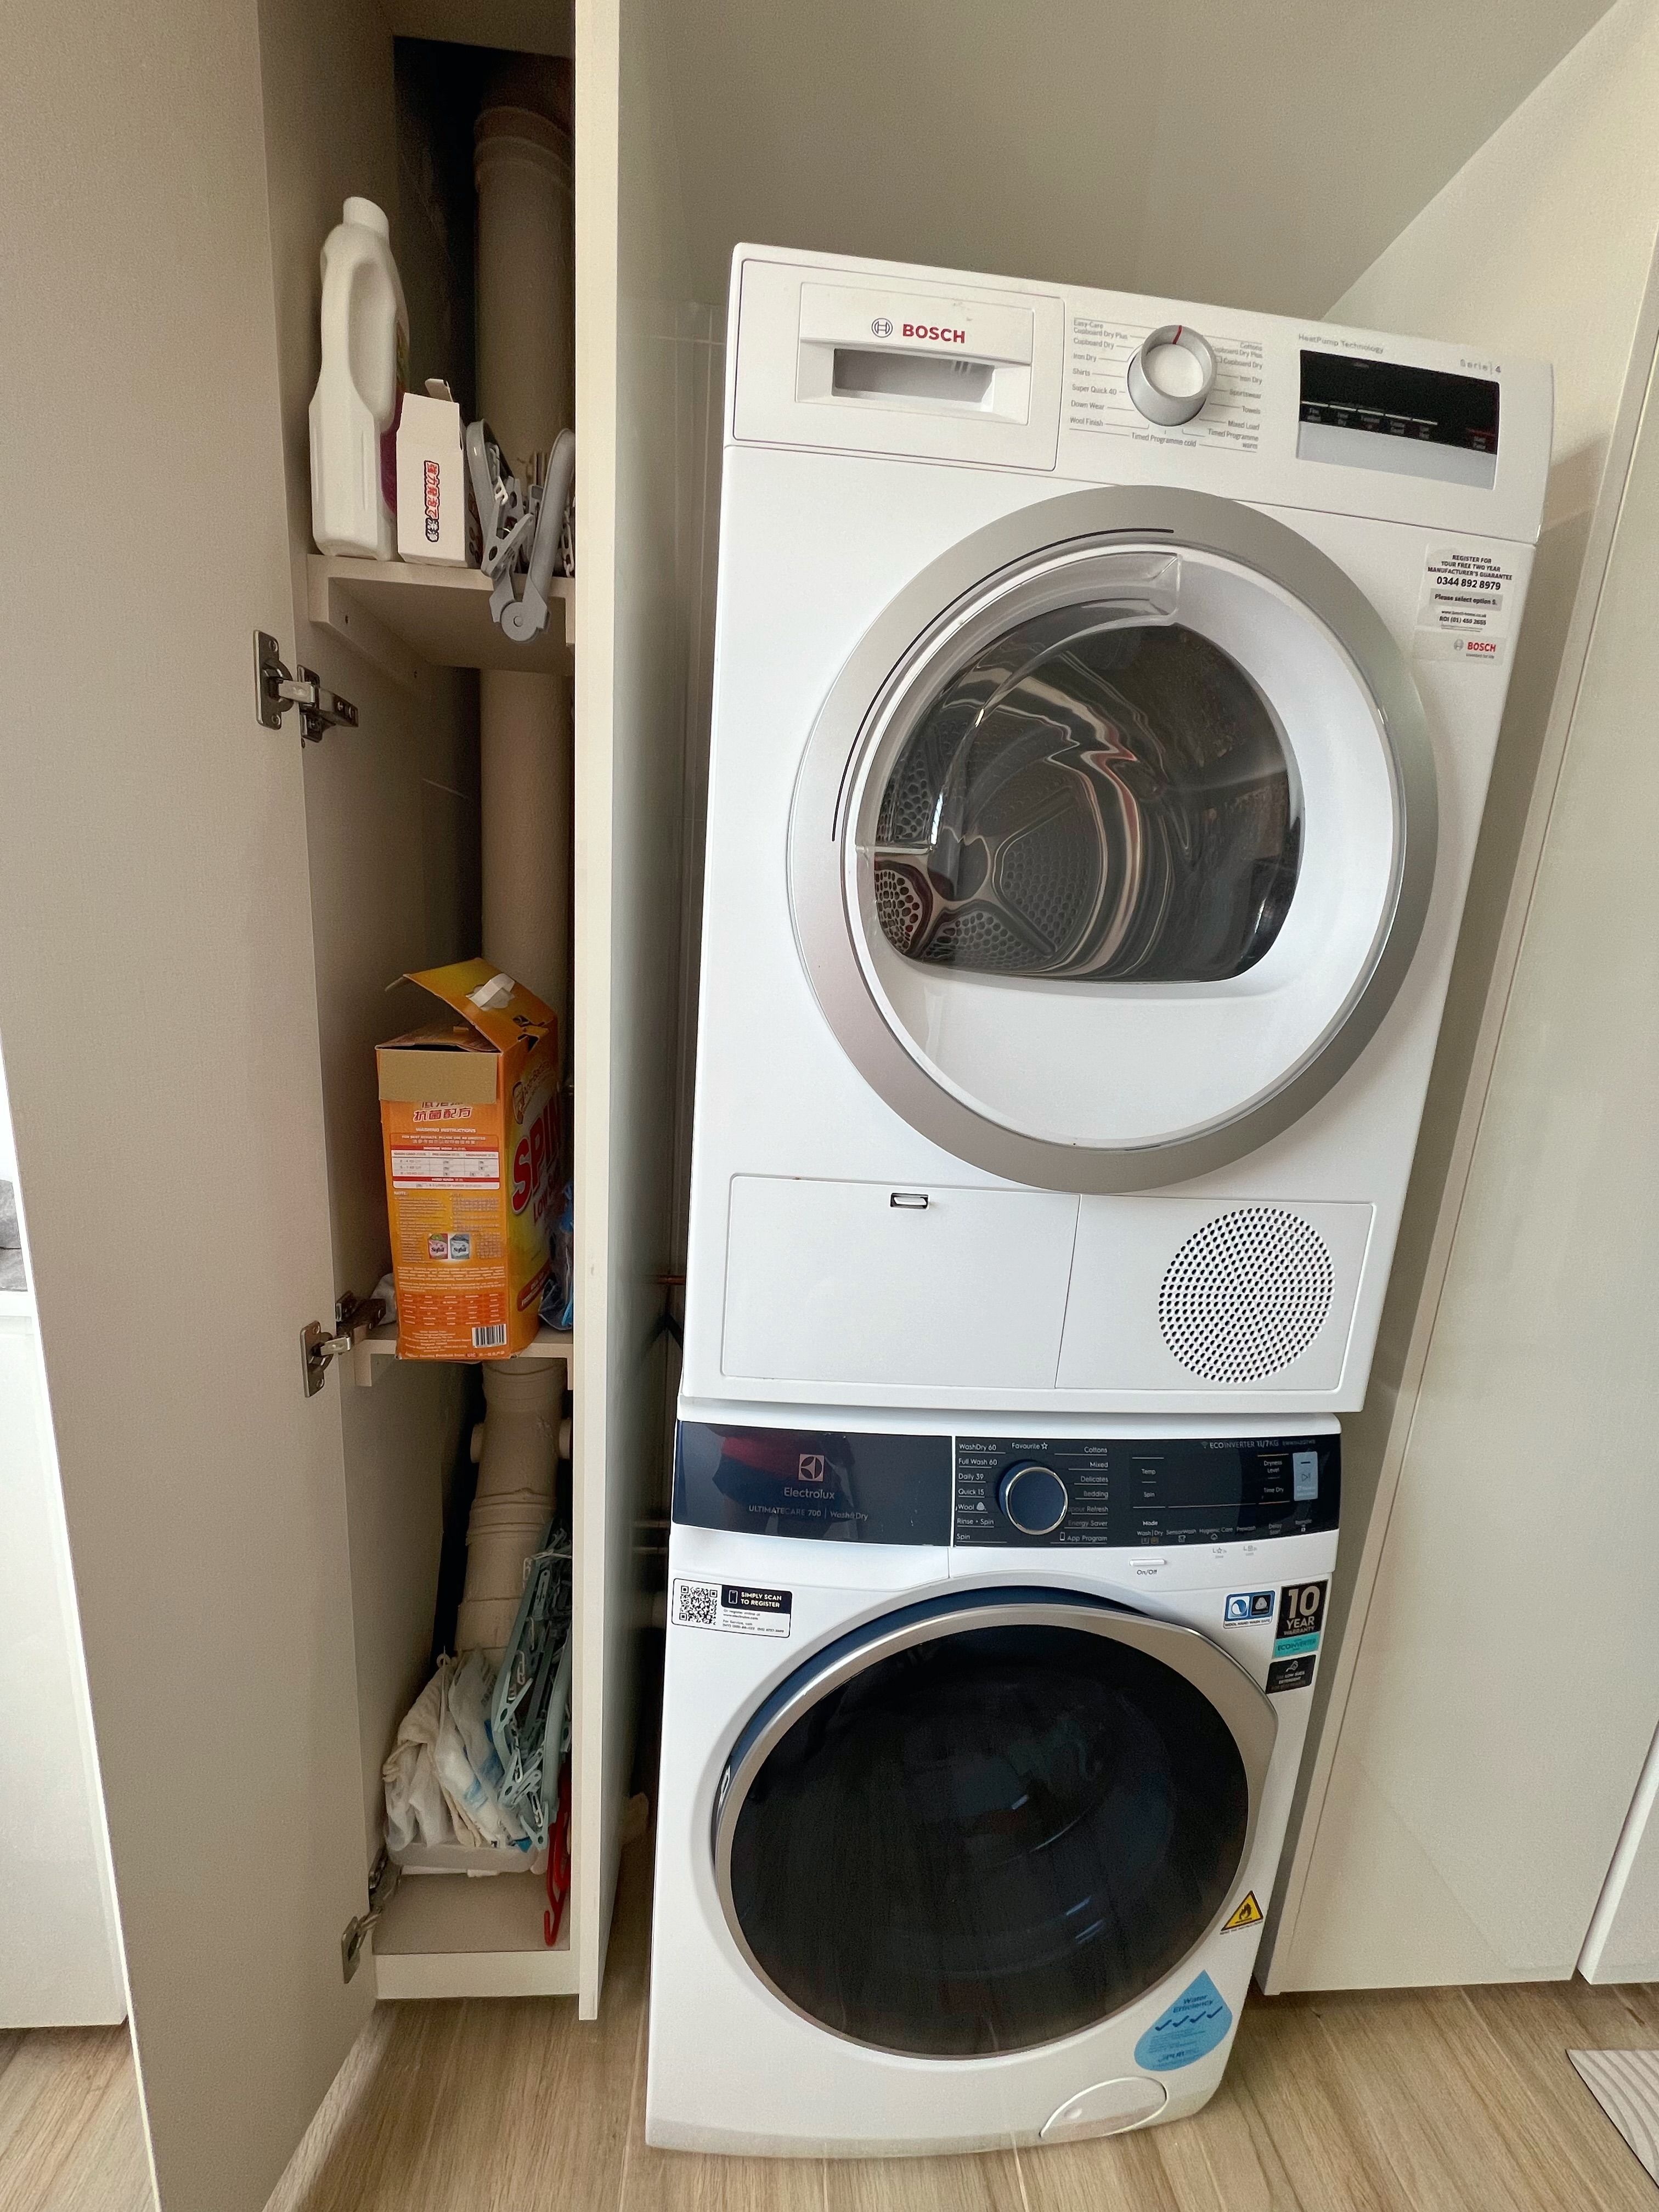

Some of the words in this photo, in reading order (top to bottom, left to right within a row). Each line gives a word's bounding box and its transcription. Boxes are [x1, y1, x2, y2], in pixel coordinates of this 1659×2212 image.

[902, 323, 966, 344] BOSCH
[1074, 328, 1103, 336] Cupboard
[1104, 330, 1114, 339] Dry
[1073, 337, 1103, 347] Cupboard
[1104, 341, 1114, 350] Dry
[1240, 342, 1262, 351] Cottons
[1341, 340, 1384, 354] Technology
[1086, 354, 1097, 362] Dry
[1239, 349, 1249, 358] Dry
[1223, 358, 1251, 367] Cupboard
[1252, 362, 1263, 370] Dry
[1073, 368, 1091, 376] Shirts
[1252, 376, 1262, 385] Dry
[1072, 384, 1089, 392] Super
[1091, 386, 1108, 394] Quick
[1229, 388, 1261, 399] Sportswear
[1071, 400, 1088, 408] Down
[1242, 405, 1261, 414] Towels
[1086, 418, 1103, 426] Finish
[1228, 420, 1245, 428] Mixed
[1246, 422, 1260, 431] Load
[1132, 432, 1150, 441] Timed
[1150, 435, 1183, 445] Programme
[1208, 428, 1226, 437] Timed
[1227, 431, 1259, 442] Programme
[1452, 555, 1480, 563] REGISTER
[1427, 567, 1479, 577] MANUFACTURER'S
[1480, 572, 1513, 580] GUARANTEE
[1436, 576, 1459, 586] 0344
[1461, 578, 1477, 589] 892
[1479, 580, 1501, 590] 8979
[1467, 642, 1497, 653] BOSCH
[414, 1107, 472, 1122] 抗菌配方
[1209, 1441, 1255, 1449] ECOINVERTER
[958, 1473, 974, 1481] Daily
[783, 1487, 836, 1500] Electrolux
[1083, 1491, 1109, 1499] Bedding
[748, 1505, 806, 1516] ULTIMATECARE
[751, 1600, 780, 1608] REGISTER
[1288, 1585, 1320, 1619] 10
[1286, 1616, 1315, 1630] YEAR
[1284, 1626, 1315, 1635] WARRANTY
[1277, 1638, 1317, 1651] ECOINVERTER
[1183, 1994, 1209, 2004] Water
[1173, 2000, 1214, 2013] Efficiency
